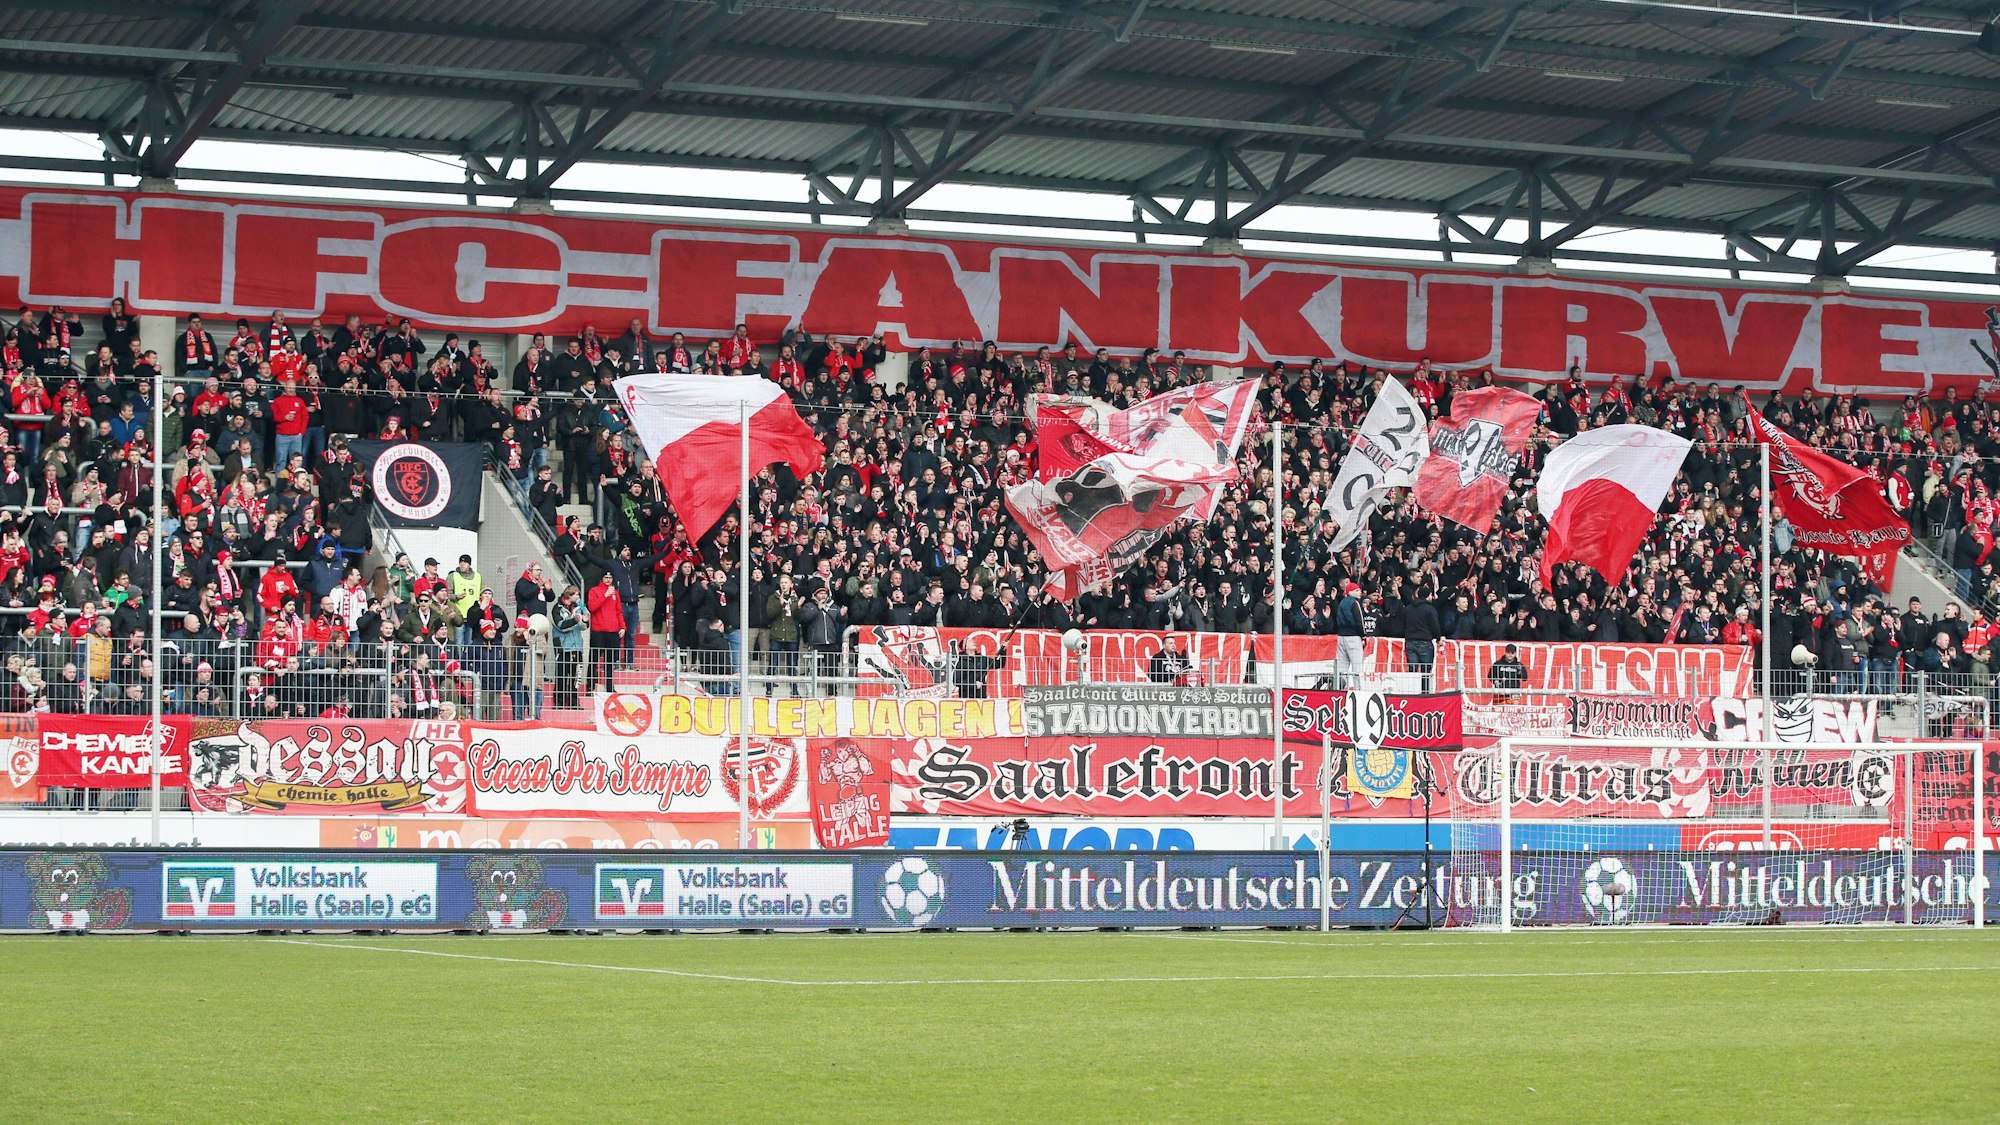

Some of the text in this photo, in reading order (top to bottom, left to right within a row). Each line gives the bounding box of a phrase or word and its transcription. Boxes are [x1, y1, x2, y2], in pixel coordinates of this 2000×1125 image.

[659, 695, 839, 738] BULLEN
[850, 696, 996, 738] JAGEN
[1567, 695, 1692, 734] Pyromanie
[425, 723, 459, 739] HF
[17, 738, 39, 753] HFC
[554, 740, 608, 794] Per
[610, 743, 711, 812] Sempre
[277, 786, 389, 802] chemie halle
[251, 867, 368, 889] Volksbank
[678, 867, 788, 889] Volksbank
[988, 859, 1540, 921] Mitteldeutsche Zeitung
[251, 894, 432, 918] Halle (Saale) eG
[678, 893, 849, 918] Halle (Saale) eG
